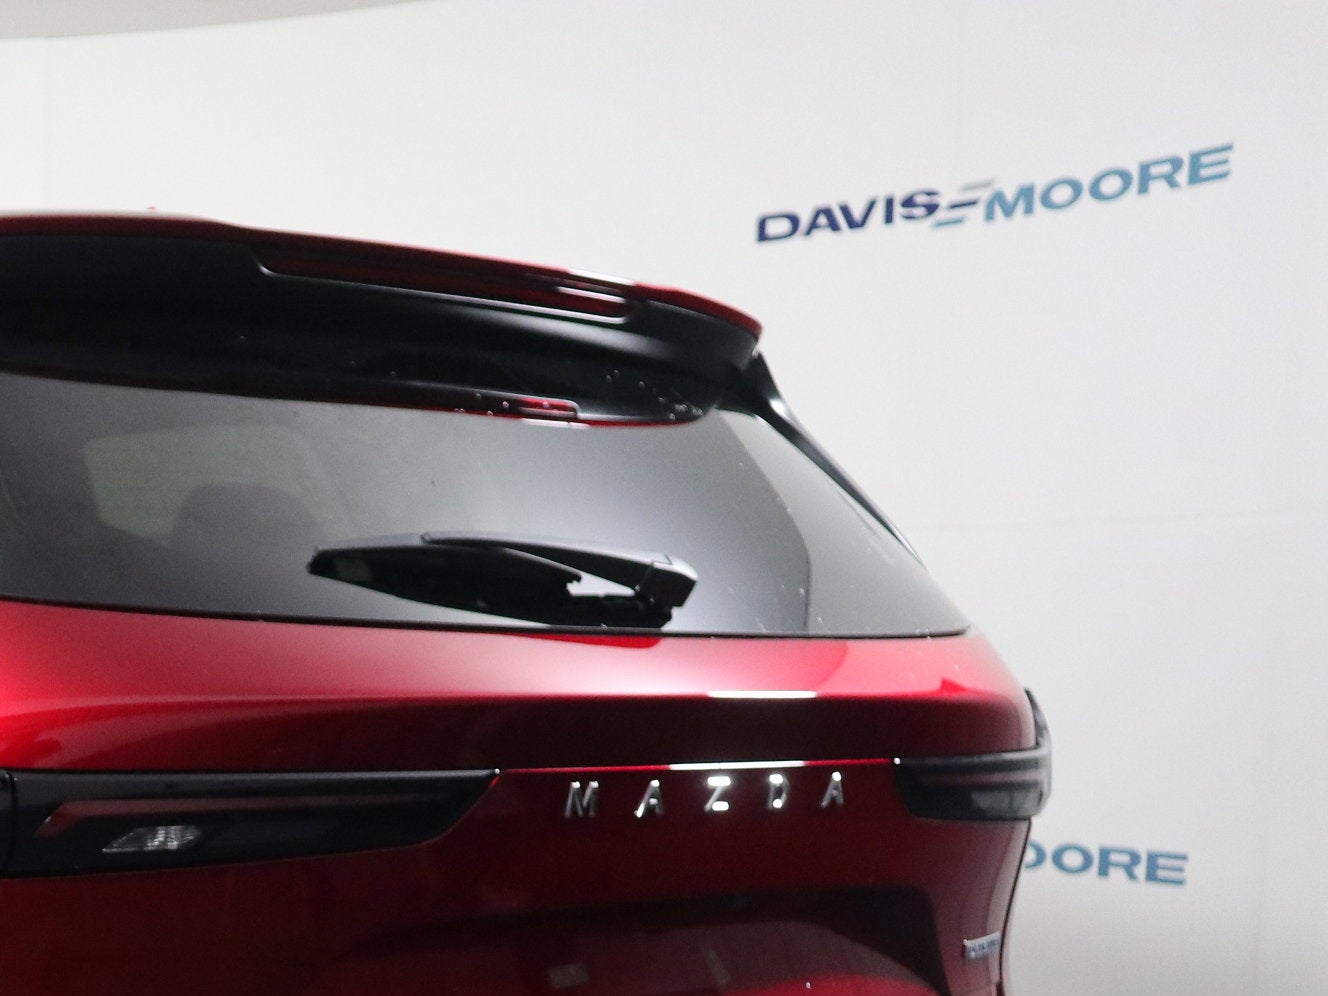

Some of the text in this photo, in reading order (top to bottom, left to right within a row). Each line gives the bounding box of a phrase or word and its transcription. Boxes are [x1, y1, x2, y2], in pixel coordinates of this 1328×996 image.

[756, 142, 1235, 242] DAVIS MOORE
[564, 770, 845, 818] MAZDA
